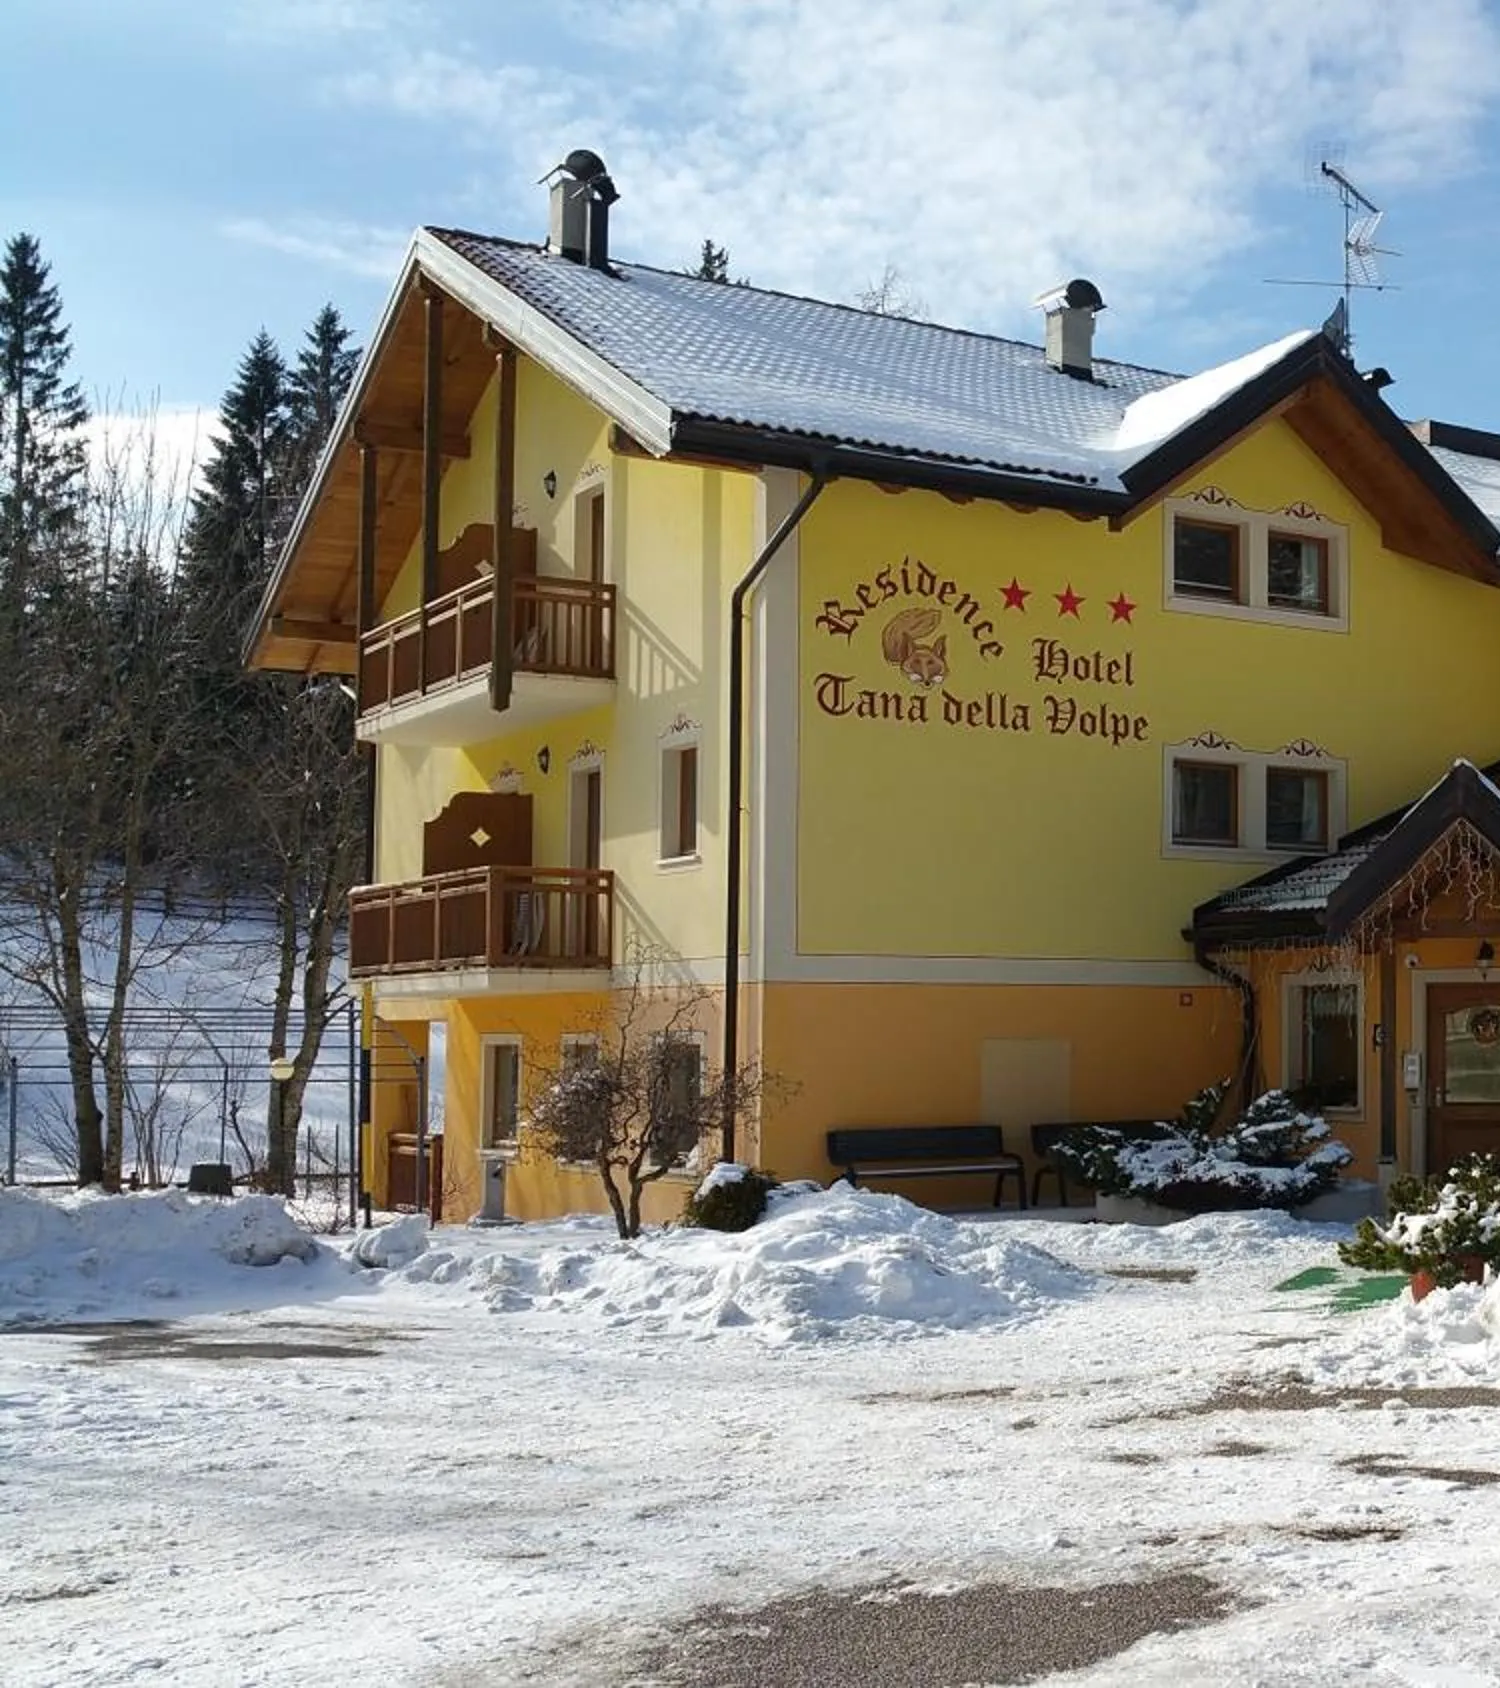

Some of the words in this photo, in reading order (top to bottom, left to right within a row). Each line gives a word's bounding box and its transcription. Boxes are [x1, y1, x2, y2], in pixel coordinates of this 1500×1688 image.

[815, 556, 1004, 662] Residence
[1032, 637, 1134, 686] Hotel
[814, 672, 928, 722] Tana
[942, 689, 1031, 732] della
[1043, 695, 1150, 746] Volpe
